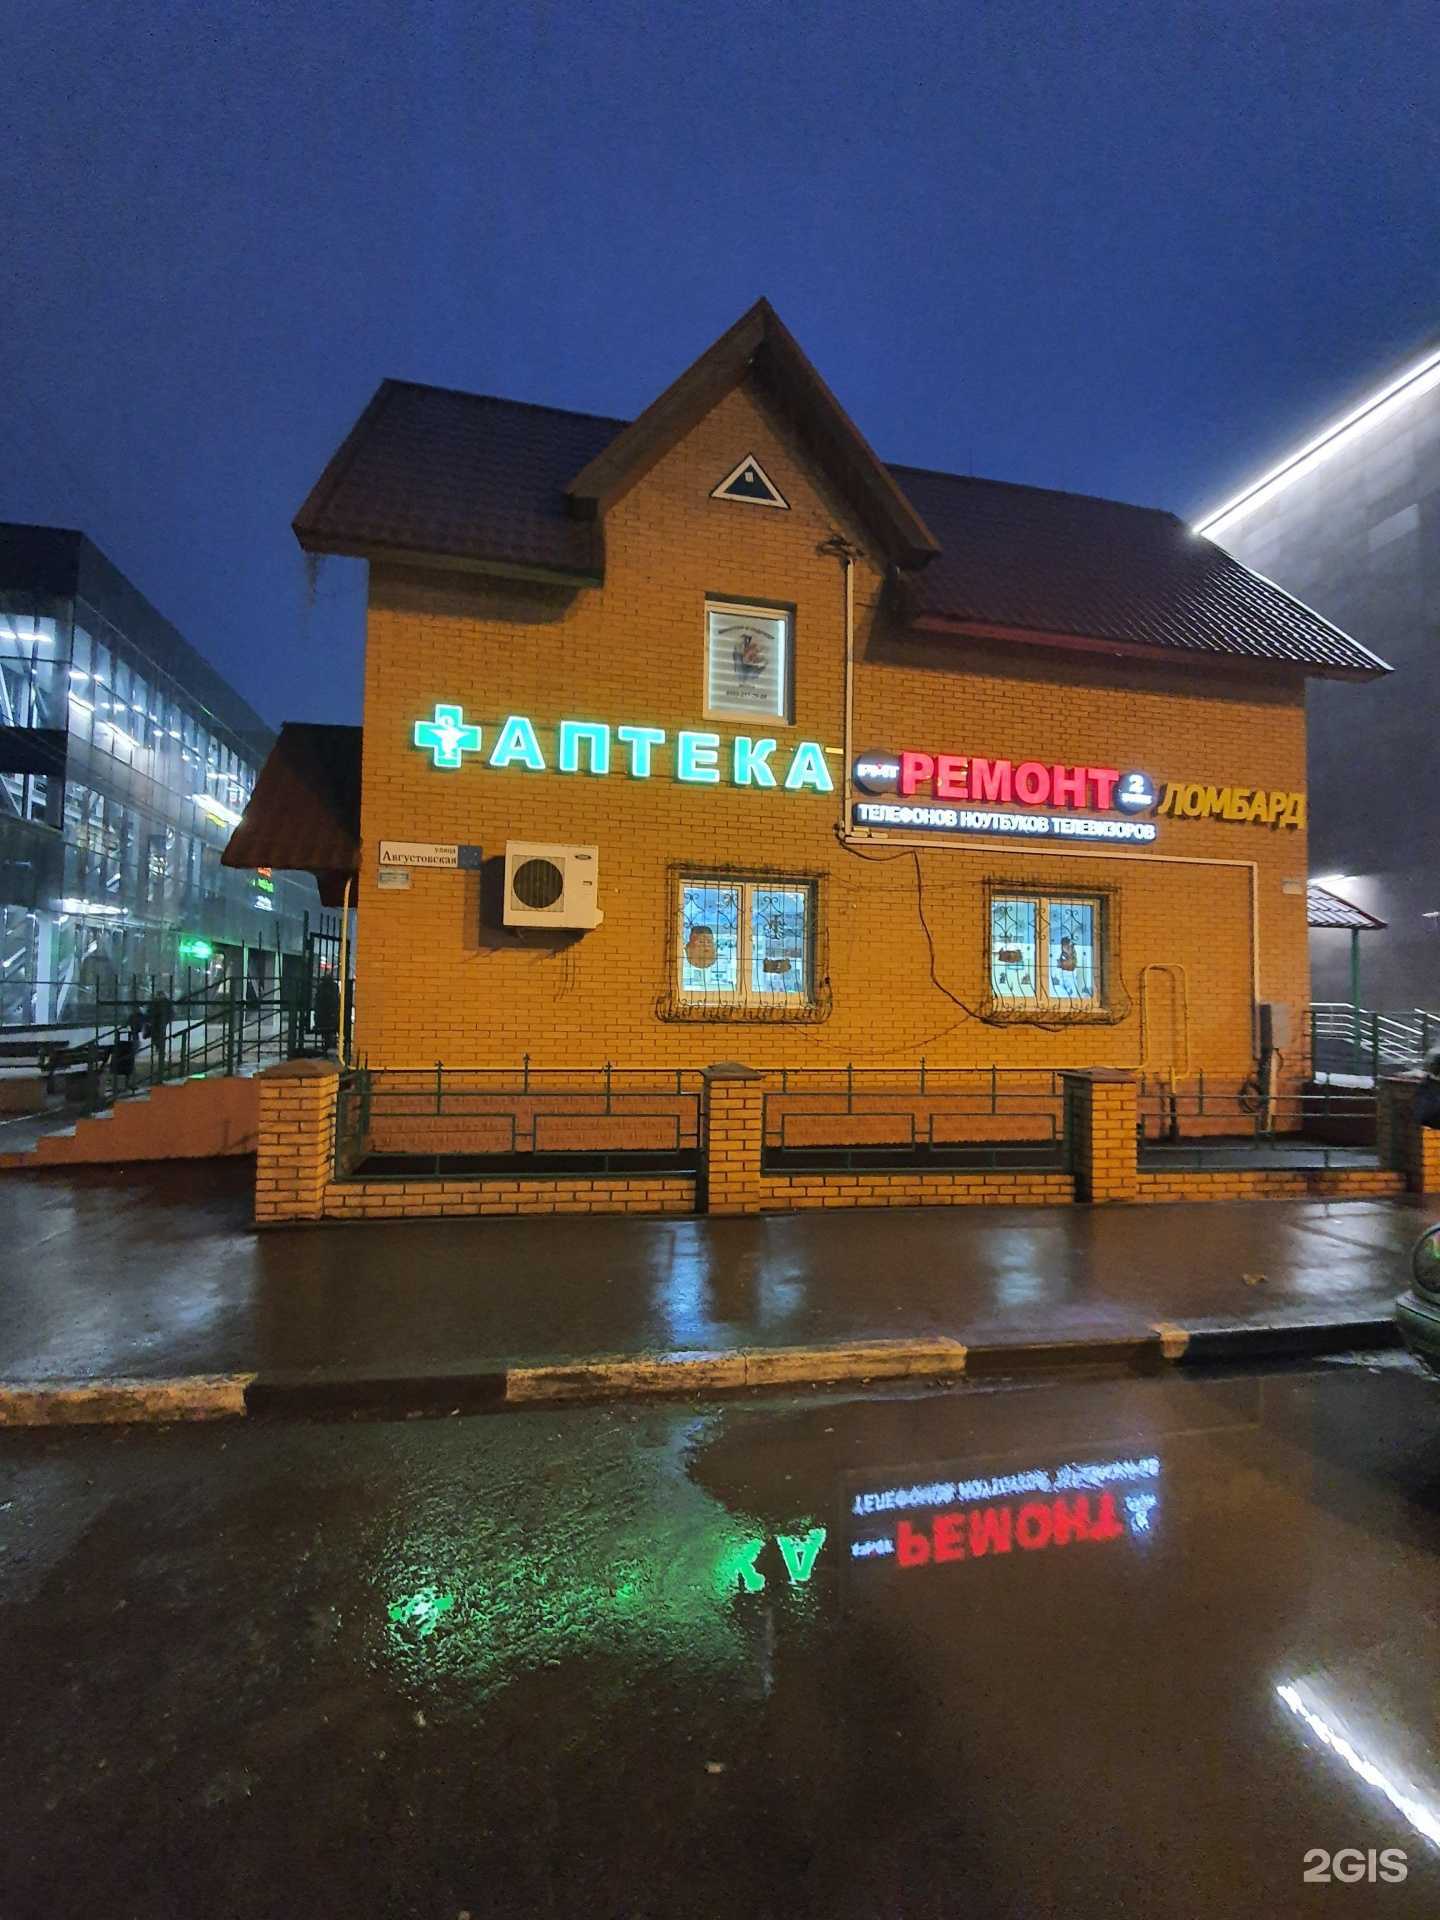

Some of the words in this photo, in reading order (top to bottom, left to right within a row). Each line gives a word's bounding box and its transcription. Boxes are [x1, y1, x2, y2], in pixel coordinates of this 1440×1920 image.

[490, 716, 834, 791] АПТЕКА
[900, 752, 1119, 809] РЕМОНТ
[857, 803, 958, 827] ТЕЛЕФОНОВ
[960, 811, 1049, 833] НОУТБУКОВ
[1051, 817, 1156, 840] ТЕЛЕВИЗОРОВ
[1157, 782, 1307, 830] ЛОМБАРД
[382, 850, 457, 864] Августовская
